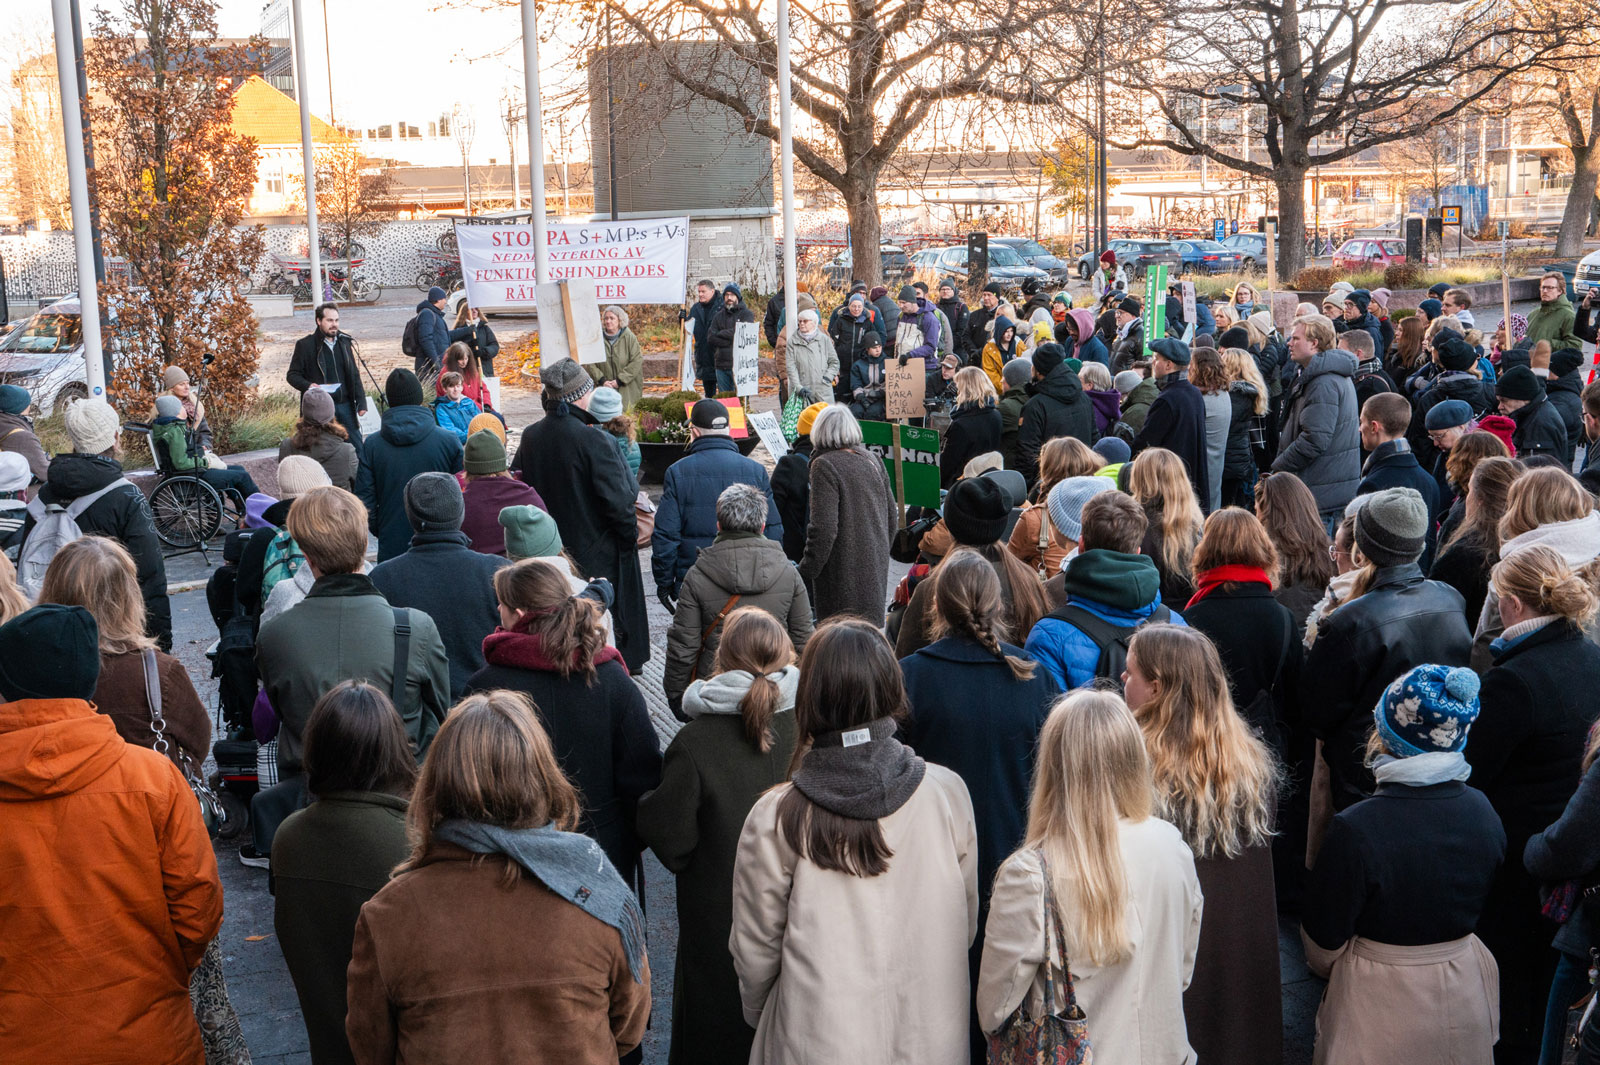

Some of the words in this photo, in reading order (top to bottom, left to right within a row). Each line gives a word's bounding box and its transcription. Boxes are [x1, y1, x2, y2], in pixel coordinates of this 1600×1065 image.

[492, 230, 570, 247] STOPA
[492, 247, 618, 261] NEDMNTERING
[624, 246, 645, 258] AV
[506, 284, 626, 299] RÄTTER
[888, 373, 912, 381] BARA
[888, 380, 899, 390] FÅ
[888, 390, 912, 399] VARA
[889, 406, 918, 415] SJÄLV
